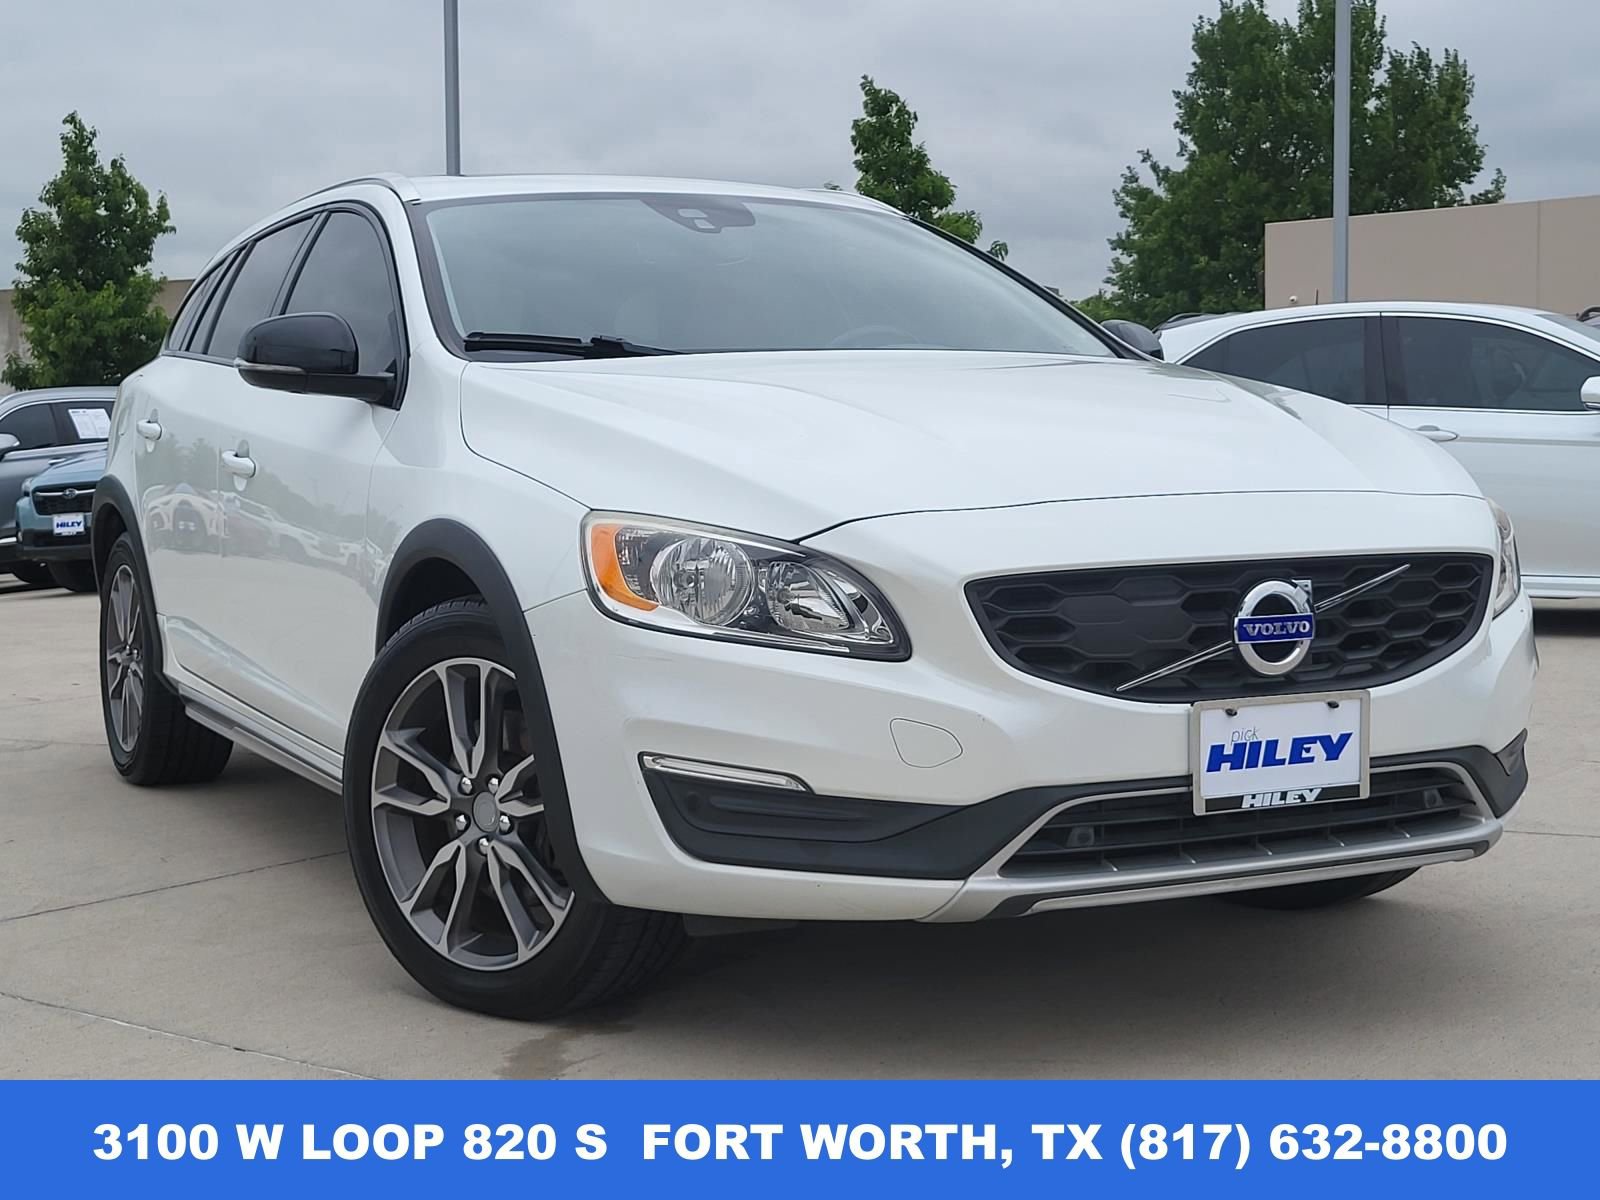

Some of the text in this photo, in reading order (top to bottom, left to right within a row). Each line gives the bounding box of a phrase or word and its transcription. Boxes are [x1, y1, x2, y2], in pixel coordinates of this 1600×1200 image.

[1243, 620, 1311, 636] VOLVO
[1230, 726, 1260, 745] pick
[1206, 732, 1353, 772] HILEY
[1241, 788, 1322, 808] HILEY
